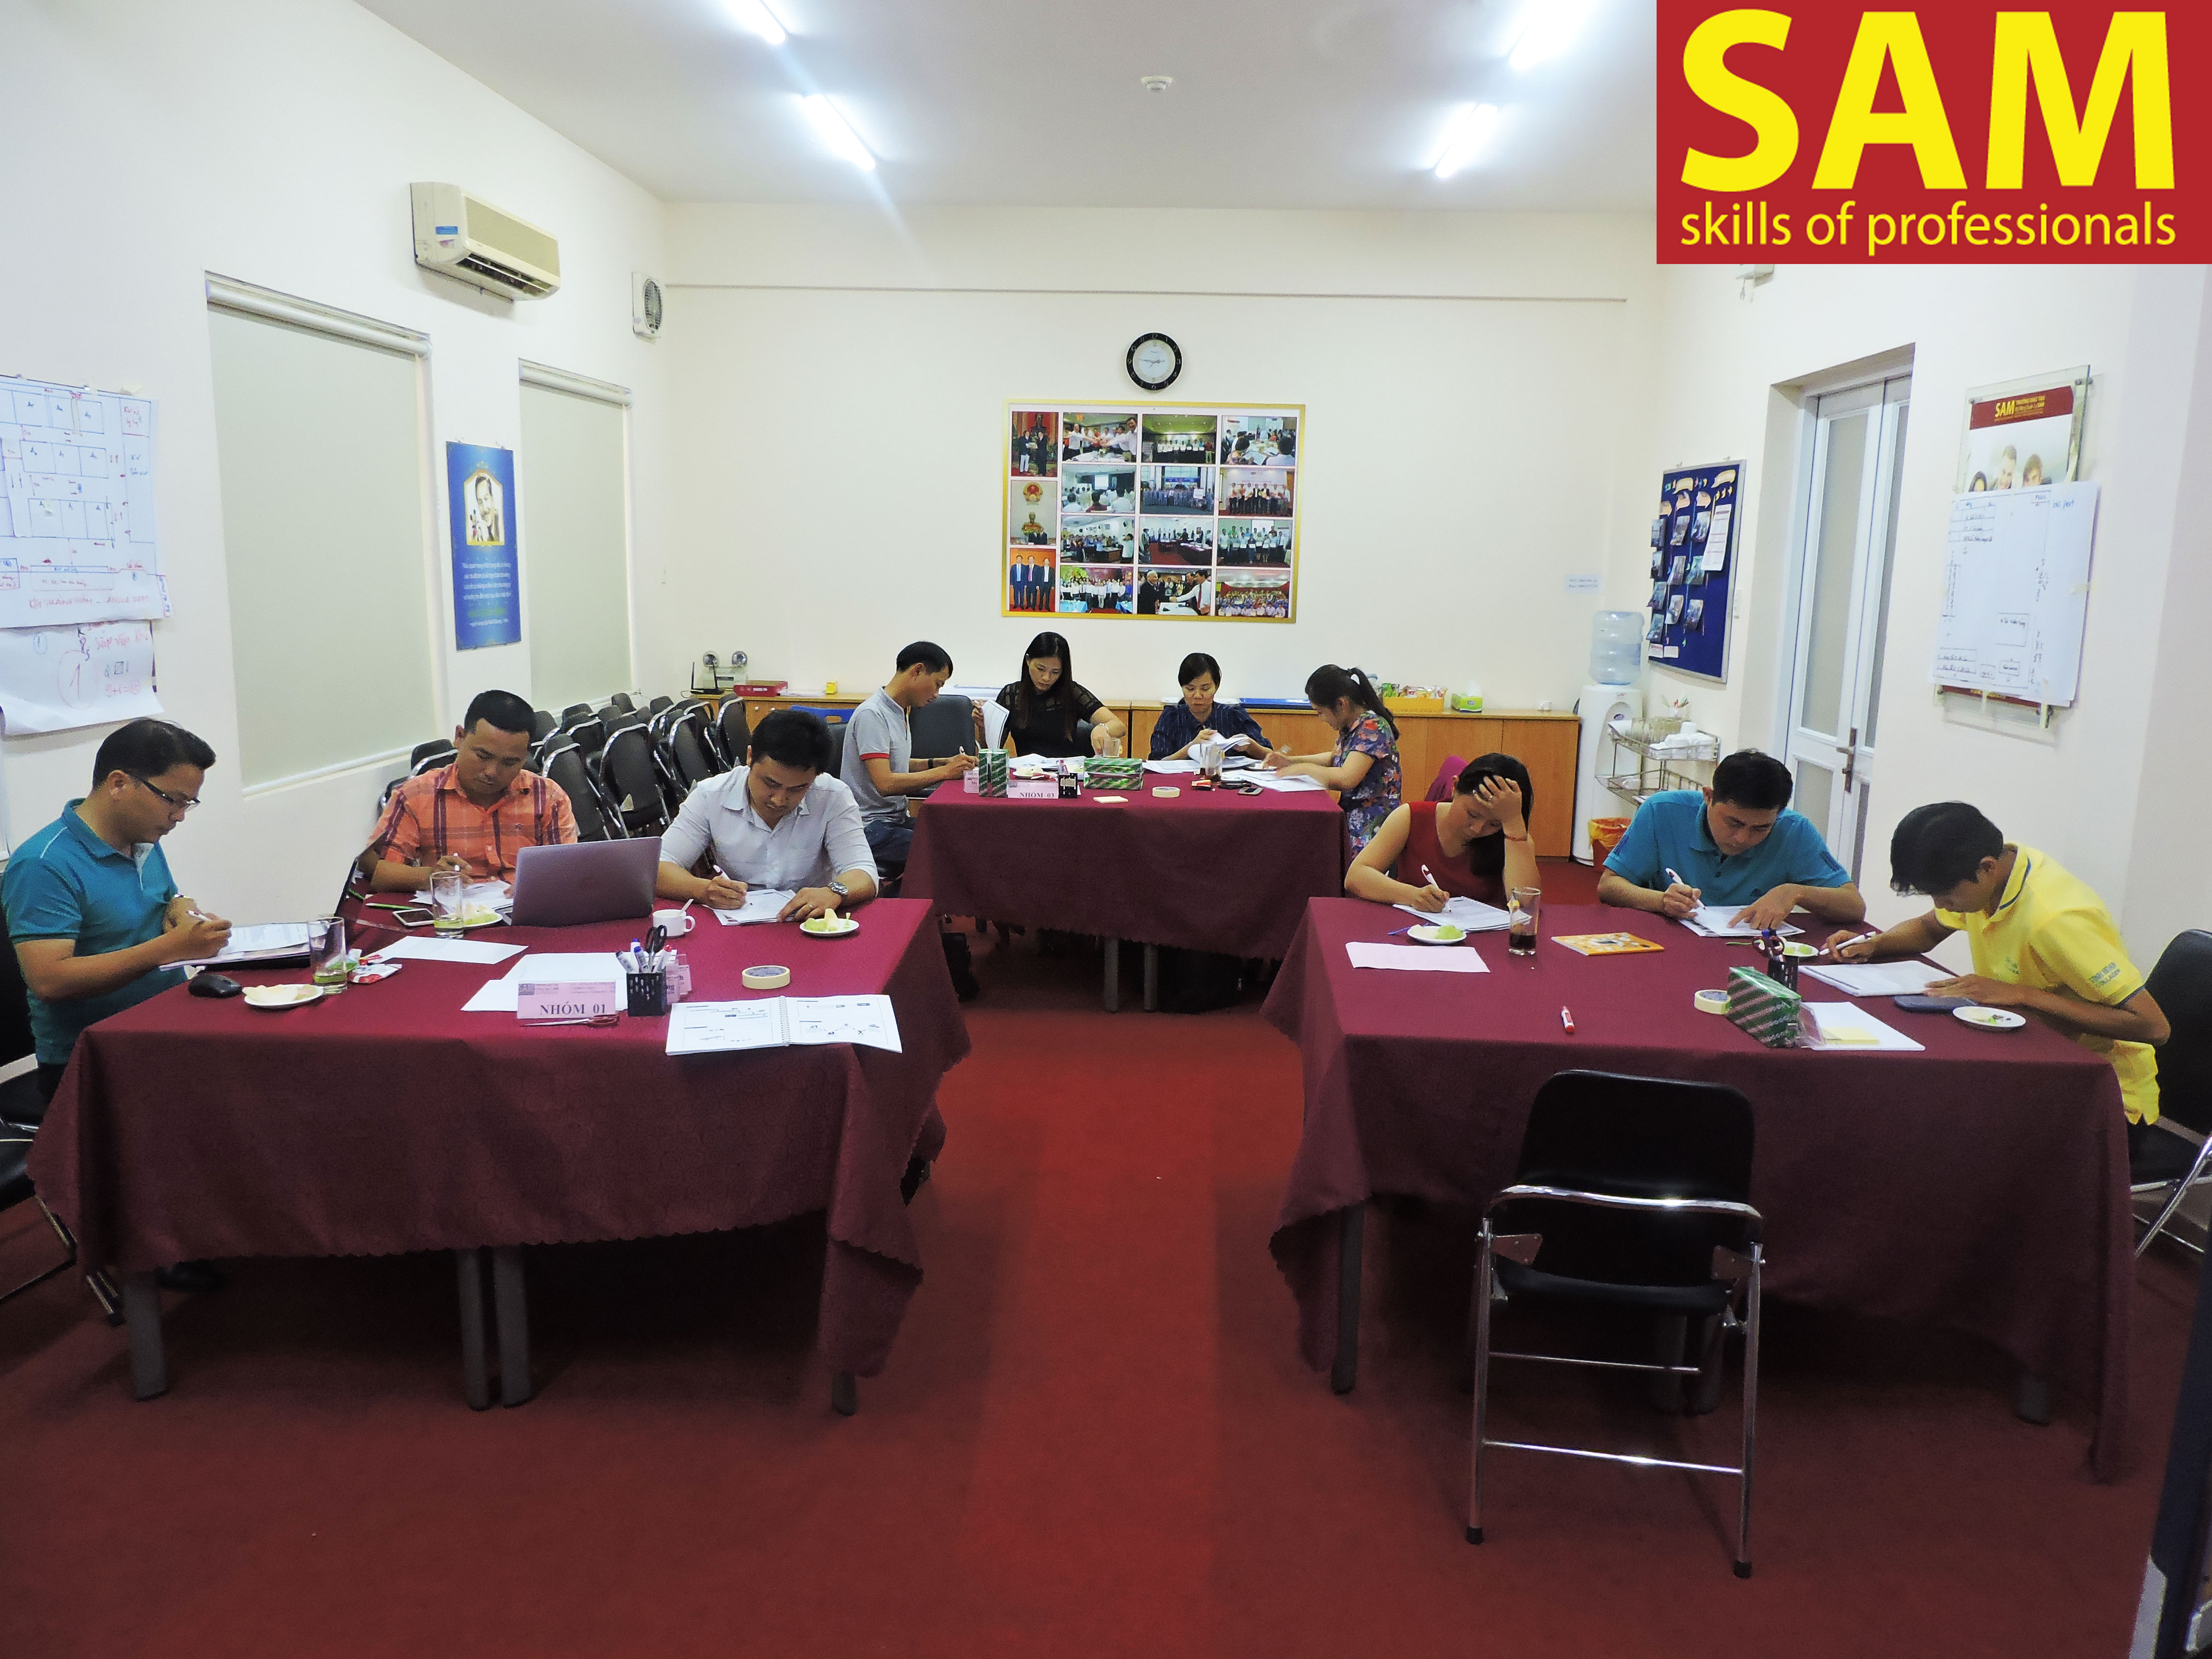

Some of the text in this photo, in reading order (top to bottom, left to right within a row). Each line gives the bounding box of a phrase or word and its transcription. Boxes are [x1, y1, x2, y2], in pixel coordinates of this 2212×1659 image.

[1995, 400, 2015, 417] SAM
[540, 1001, 606, 1015] NHÓM 01
